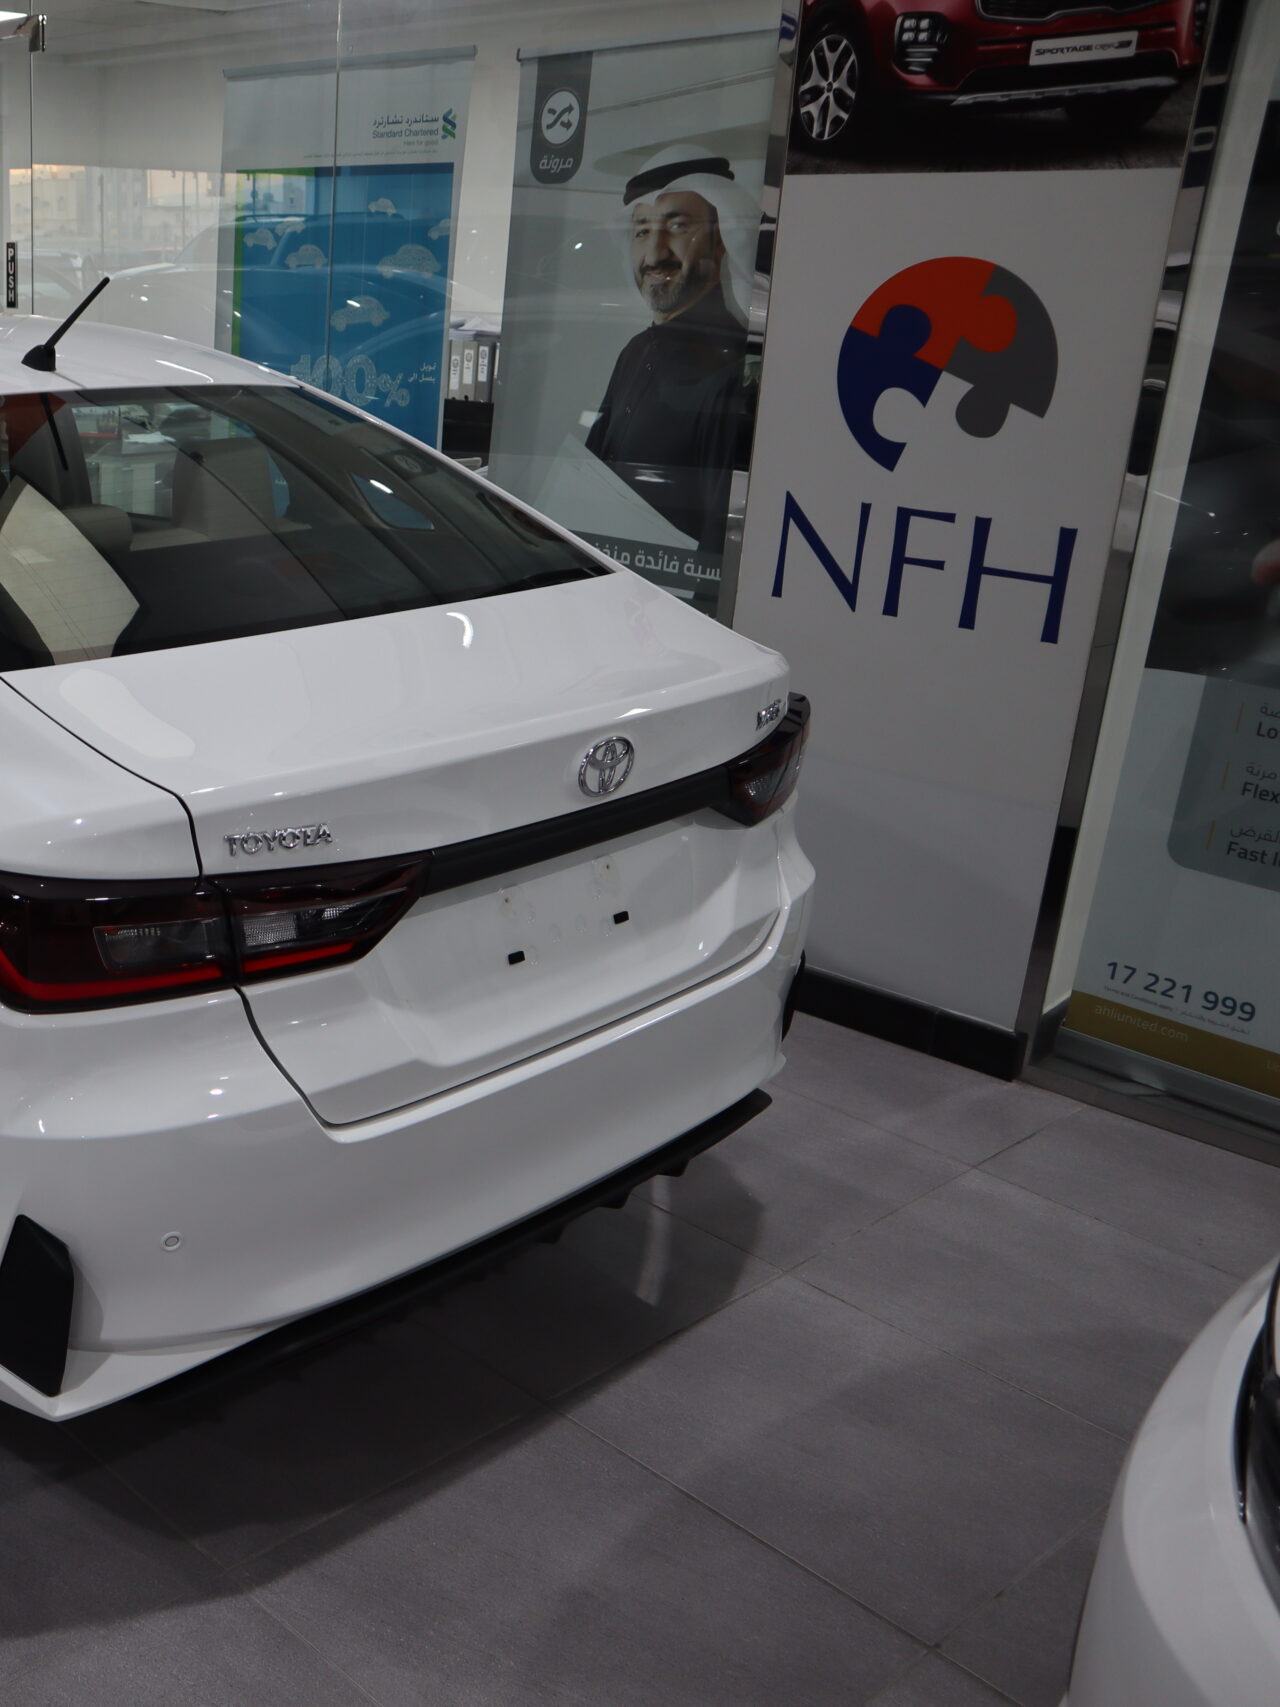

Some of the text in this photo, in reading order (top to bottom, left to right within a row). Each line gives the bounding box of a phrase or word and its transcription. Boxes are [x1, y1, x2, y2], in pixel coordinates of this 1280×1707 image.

[1033, 44, 1094, 57] SPORTAGE
[372, 127, 439, 139] Standard Chartered
[538, 154, 574, 174] مرونة
[290, 353, 411, 408] 100%
[634, 549, 680, 574] فائدة
[682, 557, 721, 582] سبة
[770, 489, 1079, 645] NFH
[1240, 781, 1280, 804] Flex
[222, 822, 334, 857] TOYOTA
[1229, 825, 1280, 843] لقرض
[1225, 840, 1268, 866] Fast
[1106, 960, 1138, 985] 17
[1143, 972, 1194, 1004] 221
[1200, 990, 1257, 1023] 999
[1094, 1003, 1190, 1042] ahliunited.com
